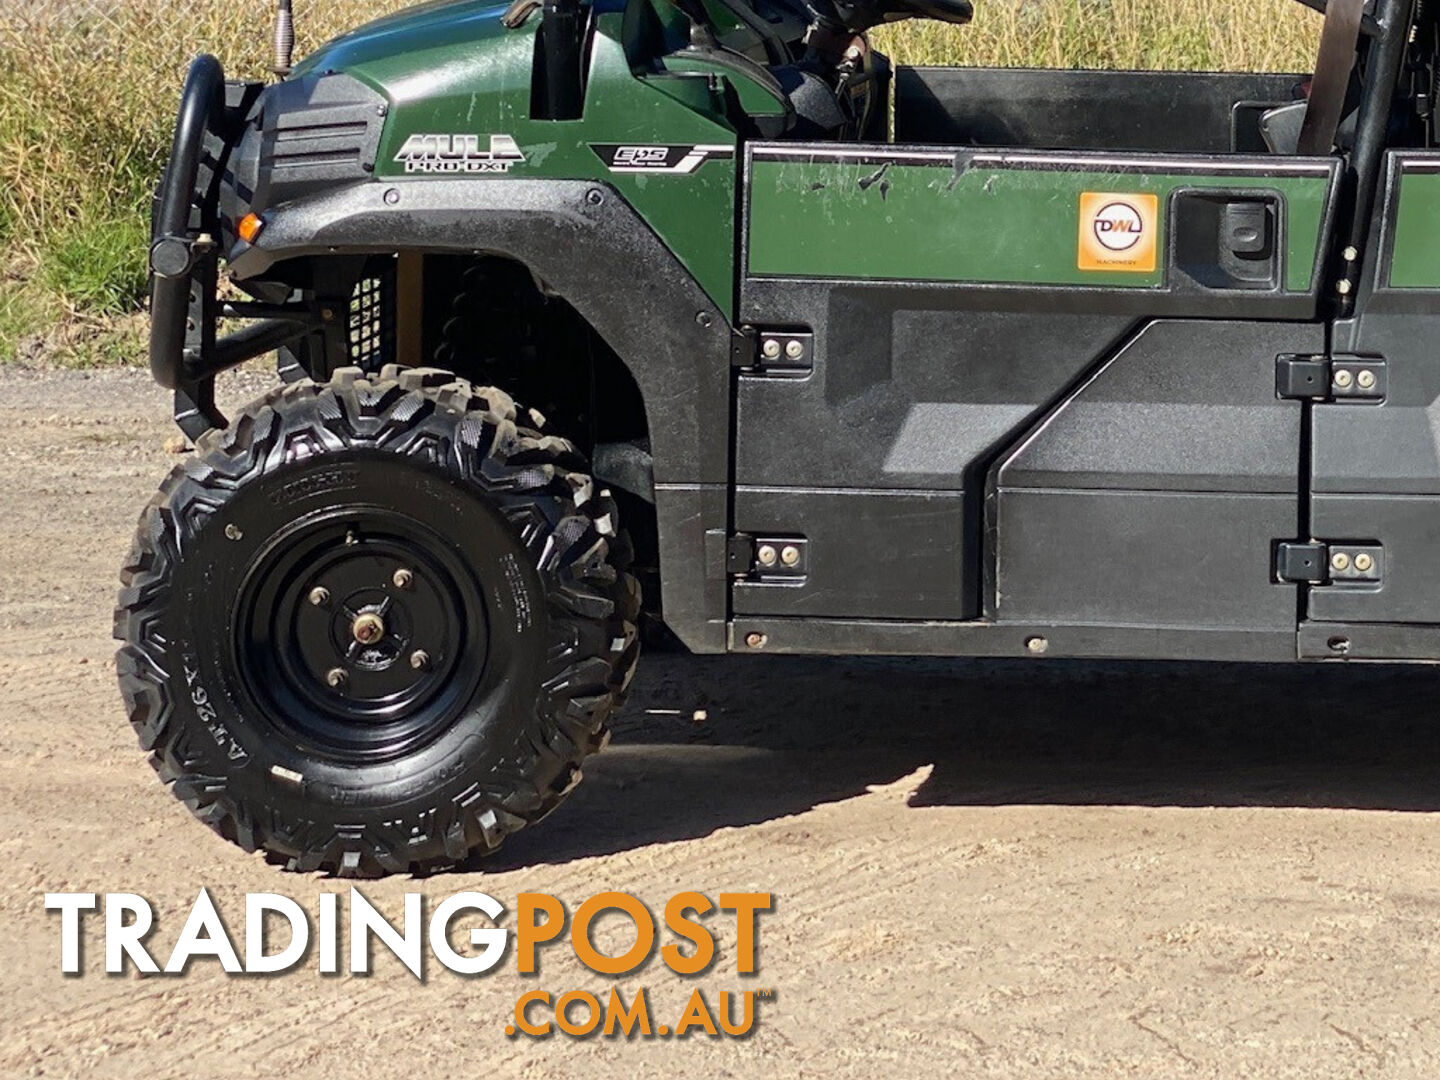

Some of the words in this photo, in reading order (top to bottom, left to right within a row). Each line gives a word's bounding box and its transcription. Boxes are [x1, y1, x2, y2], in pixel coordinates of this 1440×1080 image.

[393, 134, 526, 162] MULE
[613, 146, 669, 164] EPS
[1094, 219, 1142, 233] DWL
